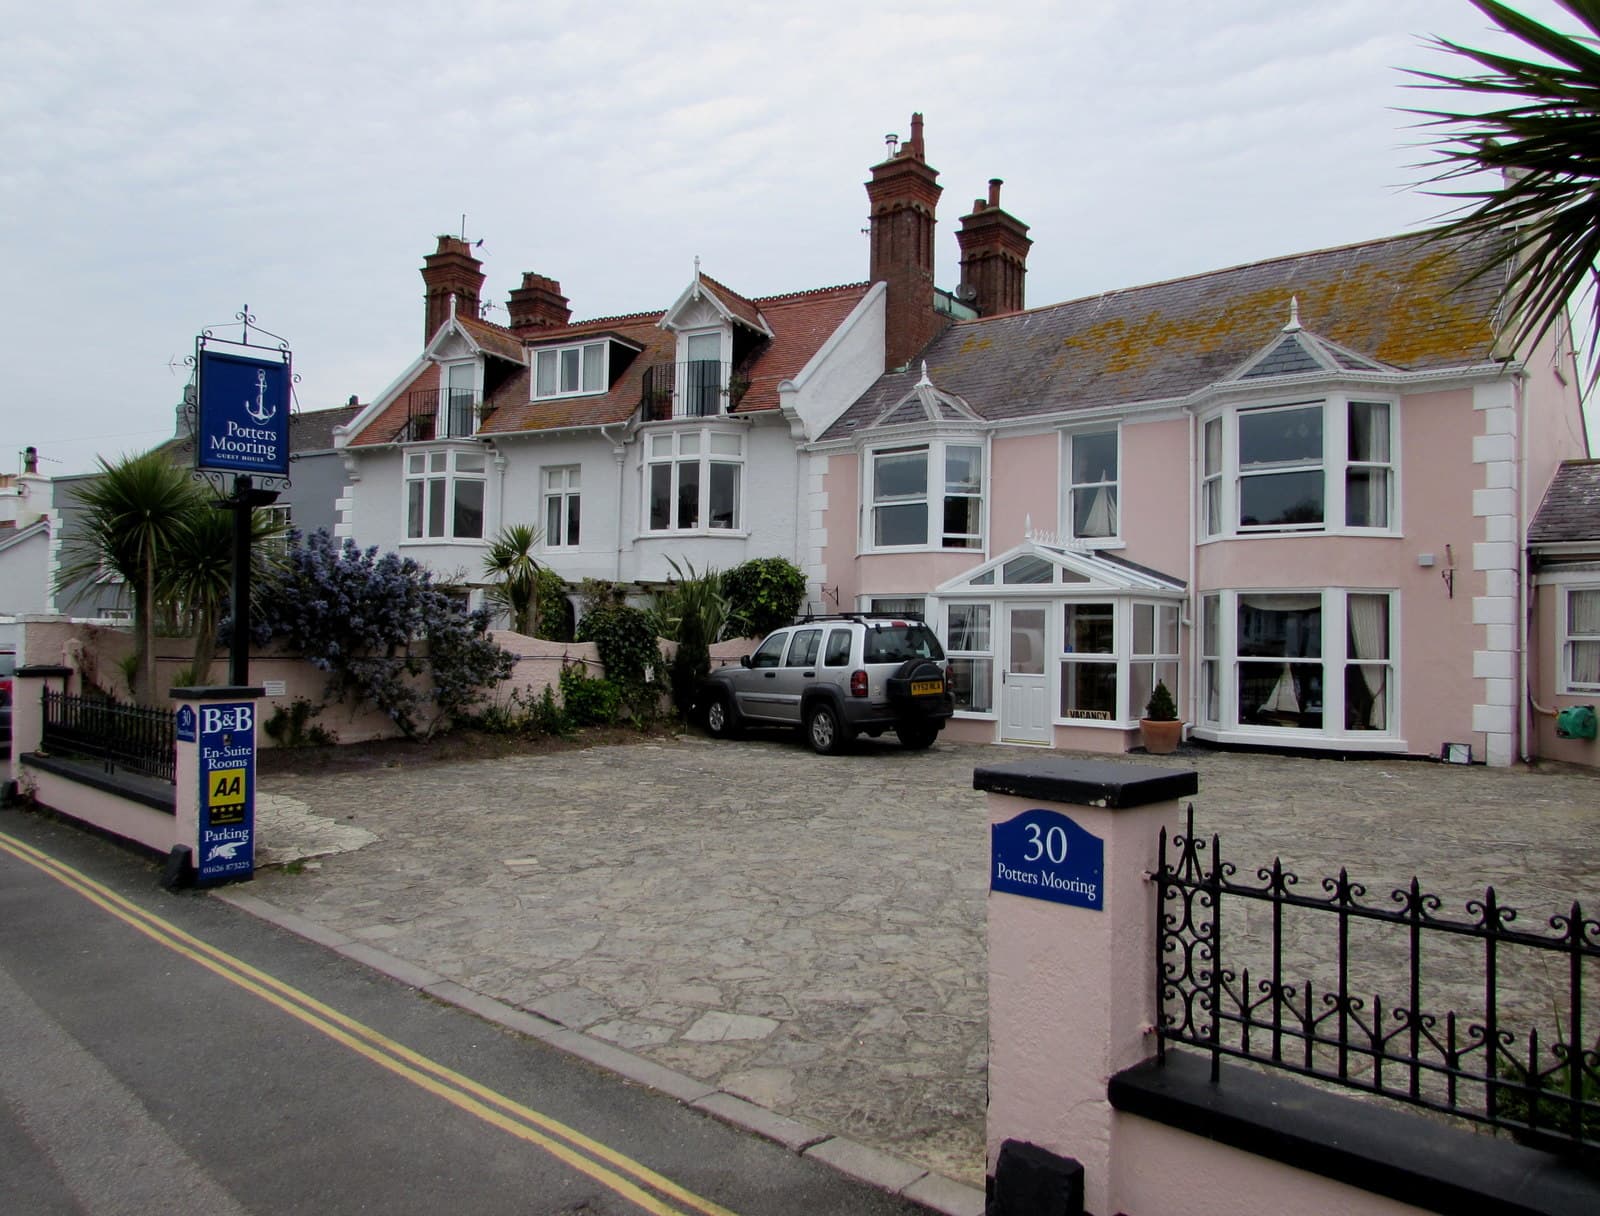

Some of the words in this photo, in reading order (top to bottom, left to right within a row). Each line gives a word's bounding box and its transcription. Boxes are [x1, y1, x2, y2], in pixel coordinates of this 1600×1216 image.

[227, 421, 277, 441] Potters
[210, 435, 277, 460] Mooring
[241, 455, 264, 463] HOUSE
[182, 710, 191, 727] 30
[202, 706, 253, 734] B&B
[1069, 710, 1108, 720] VACANCY
[203, 745, 252, 759] En-Suite
[207, 757, 248, 770] Rooms
[214, 776, 241, 797] AA
[204, 828, 249, 842] Parking
[1023, 823, 1068, 864] 30
[997, 862, 1038, 885] Potters
[1041, 870, 1096, 901] Mooring
